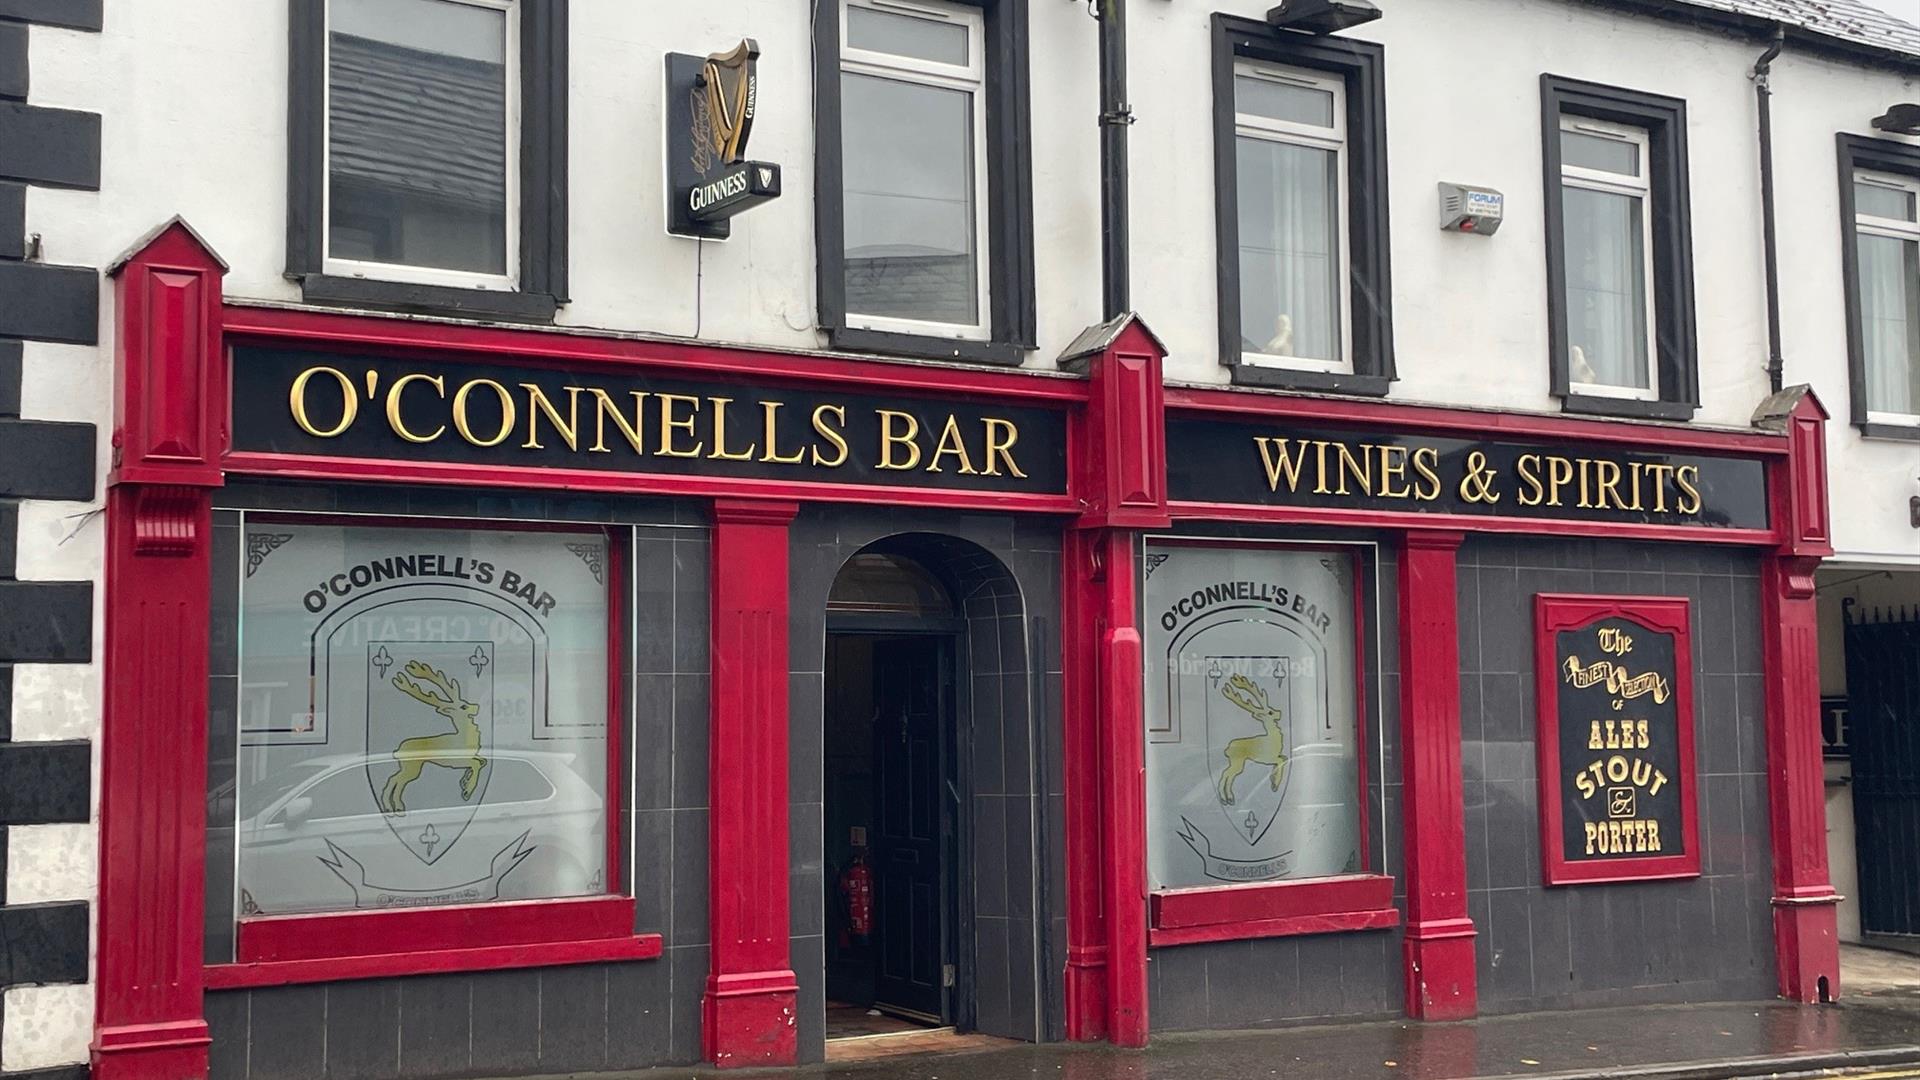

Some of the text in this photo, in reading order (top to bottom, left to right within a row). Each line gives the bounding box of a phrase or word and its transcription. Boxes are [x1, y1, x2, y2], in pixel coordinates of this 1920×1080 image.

[689, 170, 747, 211] GUINNESS
[1469, 192, 1501, 204] FORUM
[289, 365, 1028, 479] O'CONNELLS BAR
[1253, 436, 1701, 515] WINES & SPIRITS
[302, 554, 557, 619] O'CONNELL'S BAR
[1160, 581, 1331, 635] O'CONNELL'S BAR
[1598, 628, 1633, 656] The
[1577, 664, 1609, 686] FINEST
[1612, 699, 1625, 711] OF
[1588, 720, 1650, 750] ALES
[1575, 755, 1668, 799] STOUT
[1611, 791, 1632, 814] &
[1585, 820, 1661, 855] PORTER
